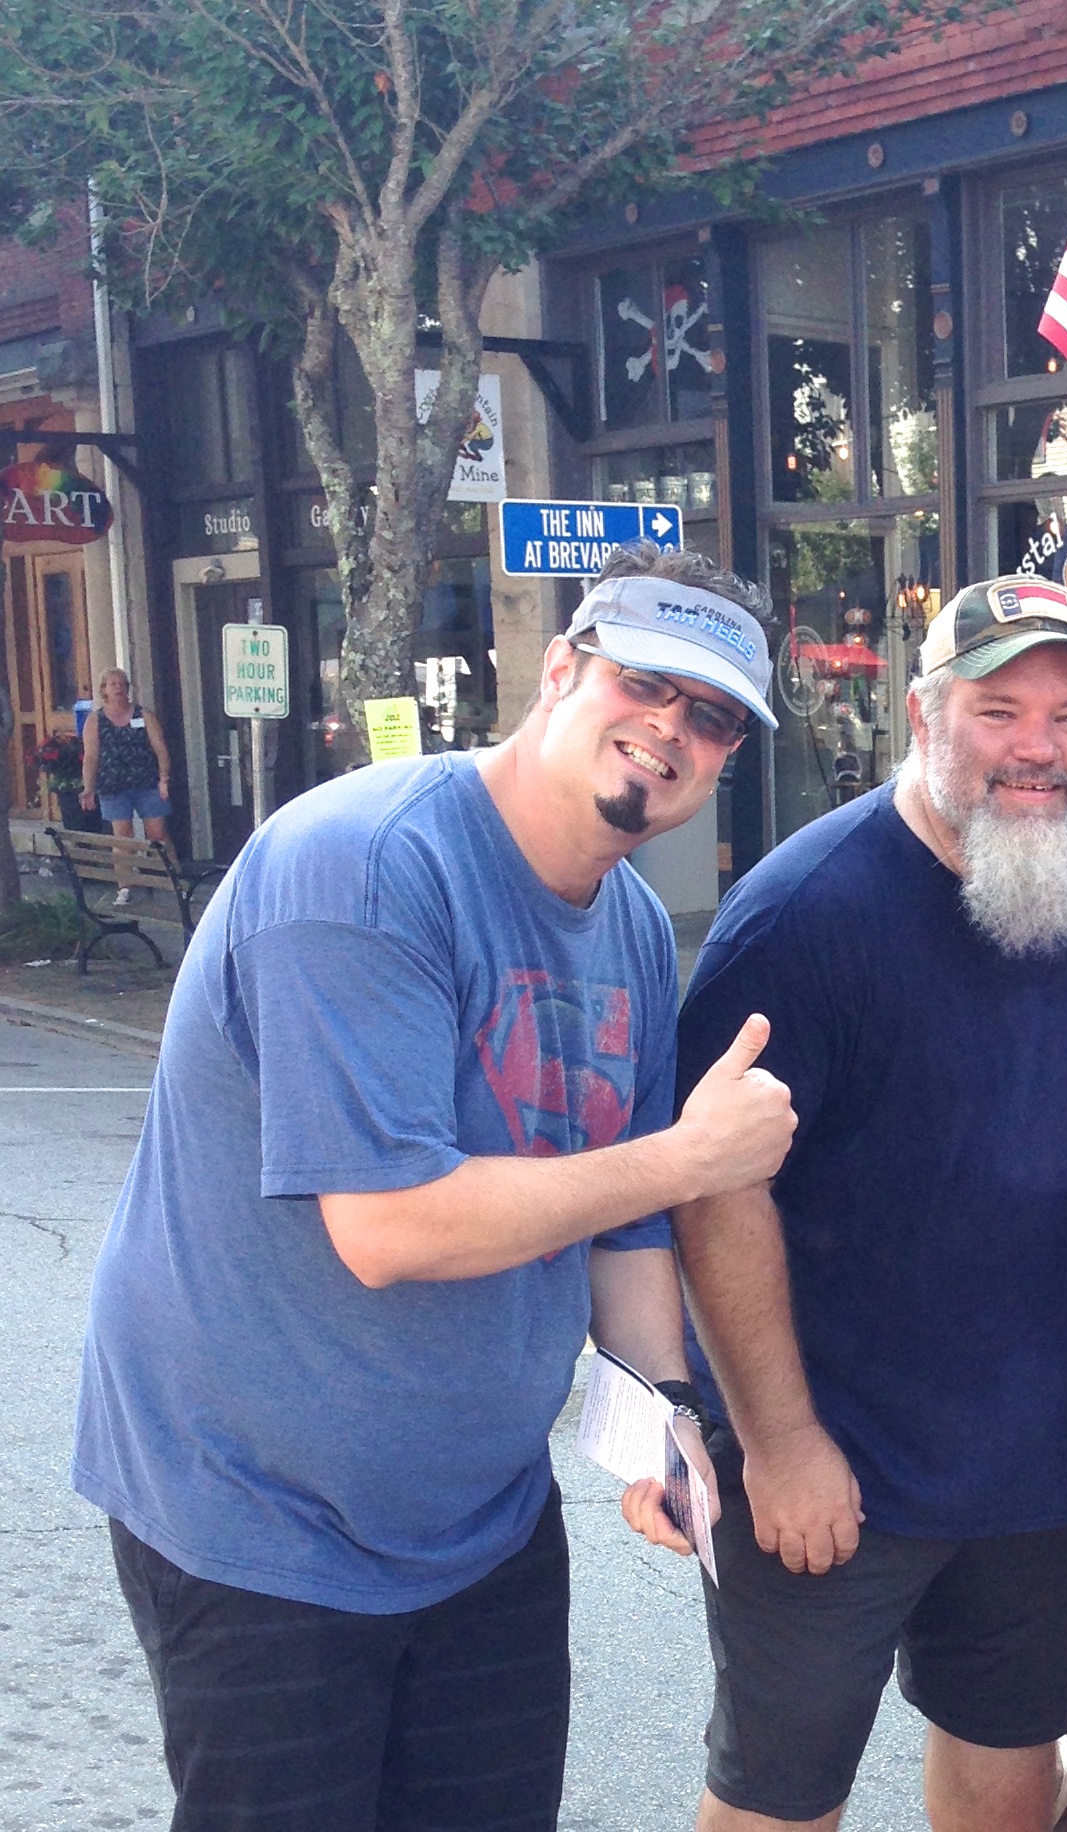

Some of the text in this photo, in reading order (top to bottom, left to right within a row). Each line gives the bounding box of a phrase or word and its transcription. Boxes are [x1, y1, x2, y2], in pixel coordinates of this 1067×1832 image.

[460, 465, 499, 482] Mine
[204, 509, 250, 535] Studio
[540, 509, 605, 538] THE INN
[524, 540, 621, 569] AT BREVAR
[694, 604, 742, 631] CAROLINA
[656, 601, 757, 663] TAR HEELS
[241, 640, 270, 657] TWO
[237, 662, 275, 680] HOUR
[228, 685, 284, 704] PARKING
